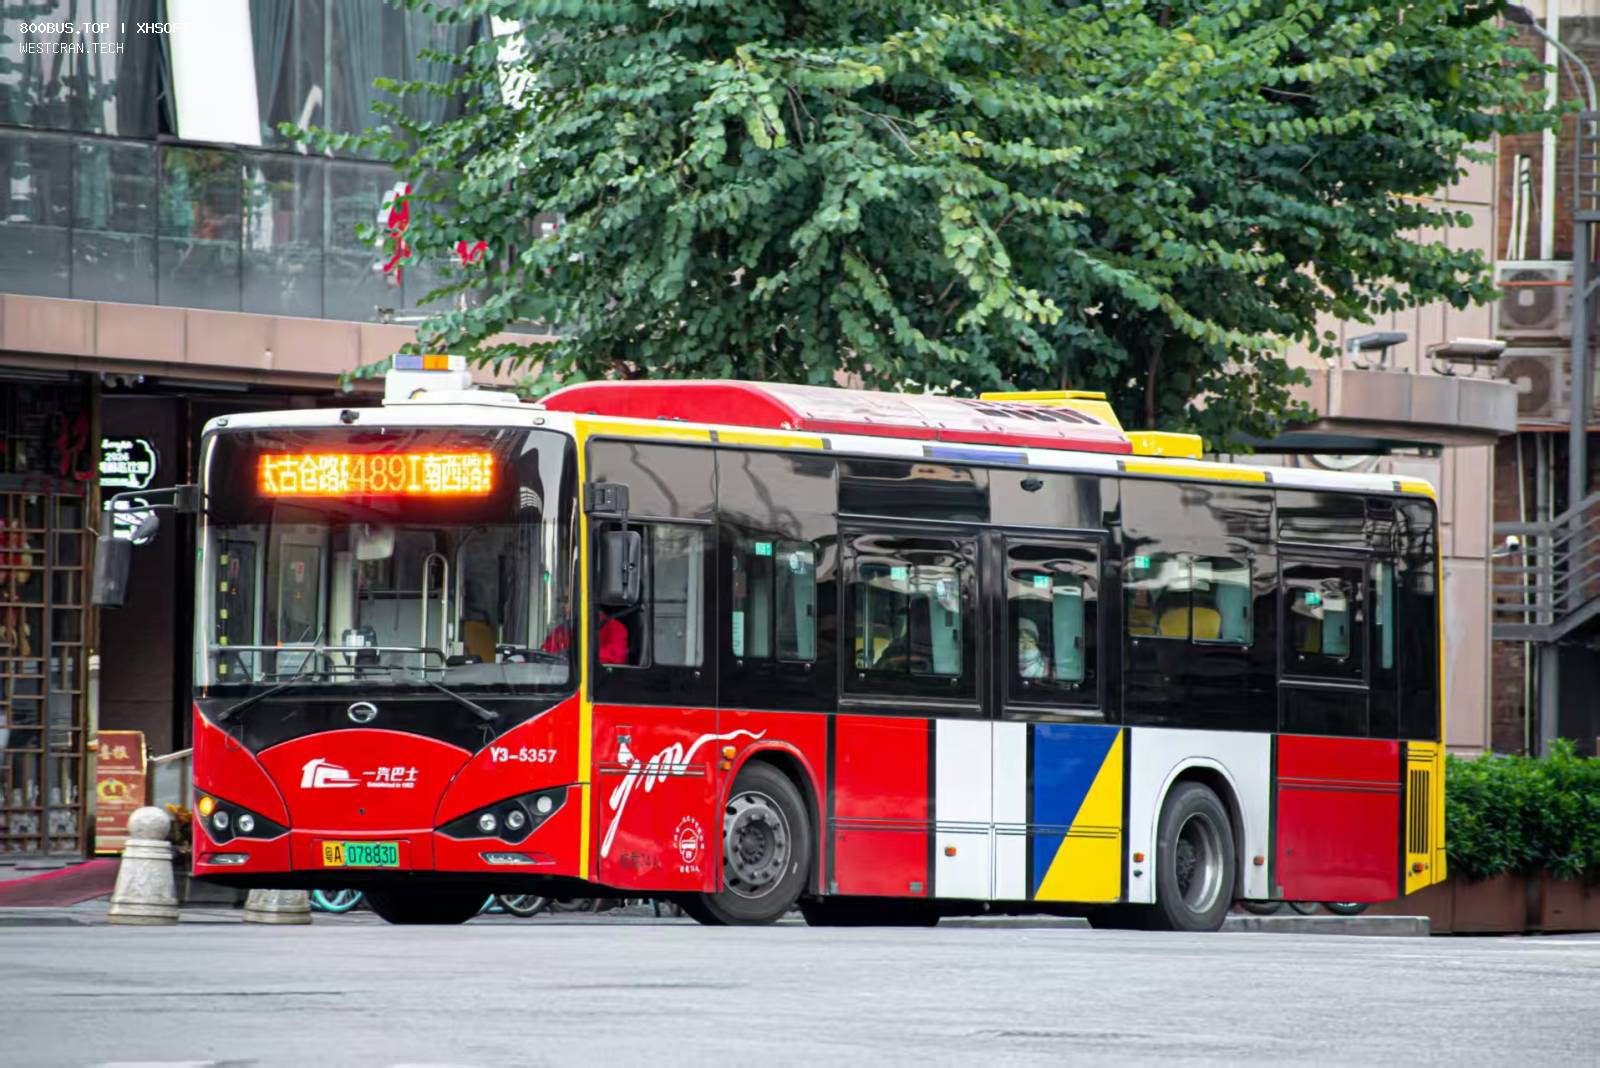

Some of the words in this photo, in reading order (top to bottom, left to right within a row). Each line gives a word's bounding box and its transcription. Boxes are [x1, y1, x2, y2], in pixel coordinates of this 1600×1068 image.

[350, 455, 407, 492] 489
[490, 747, 558, 765] Y3-5357
[362, 766, 420, 782] 一汽巴士
[348, 846, 397, 864] 07883D
